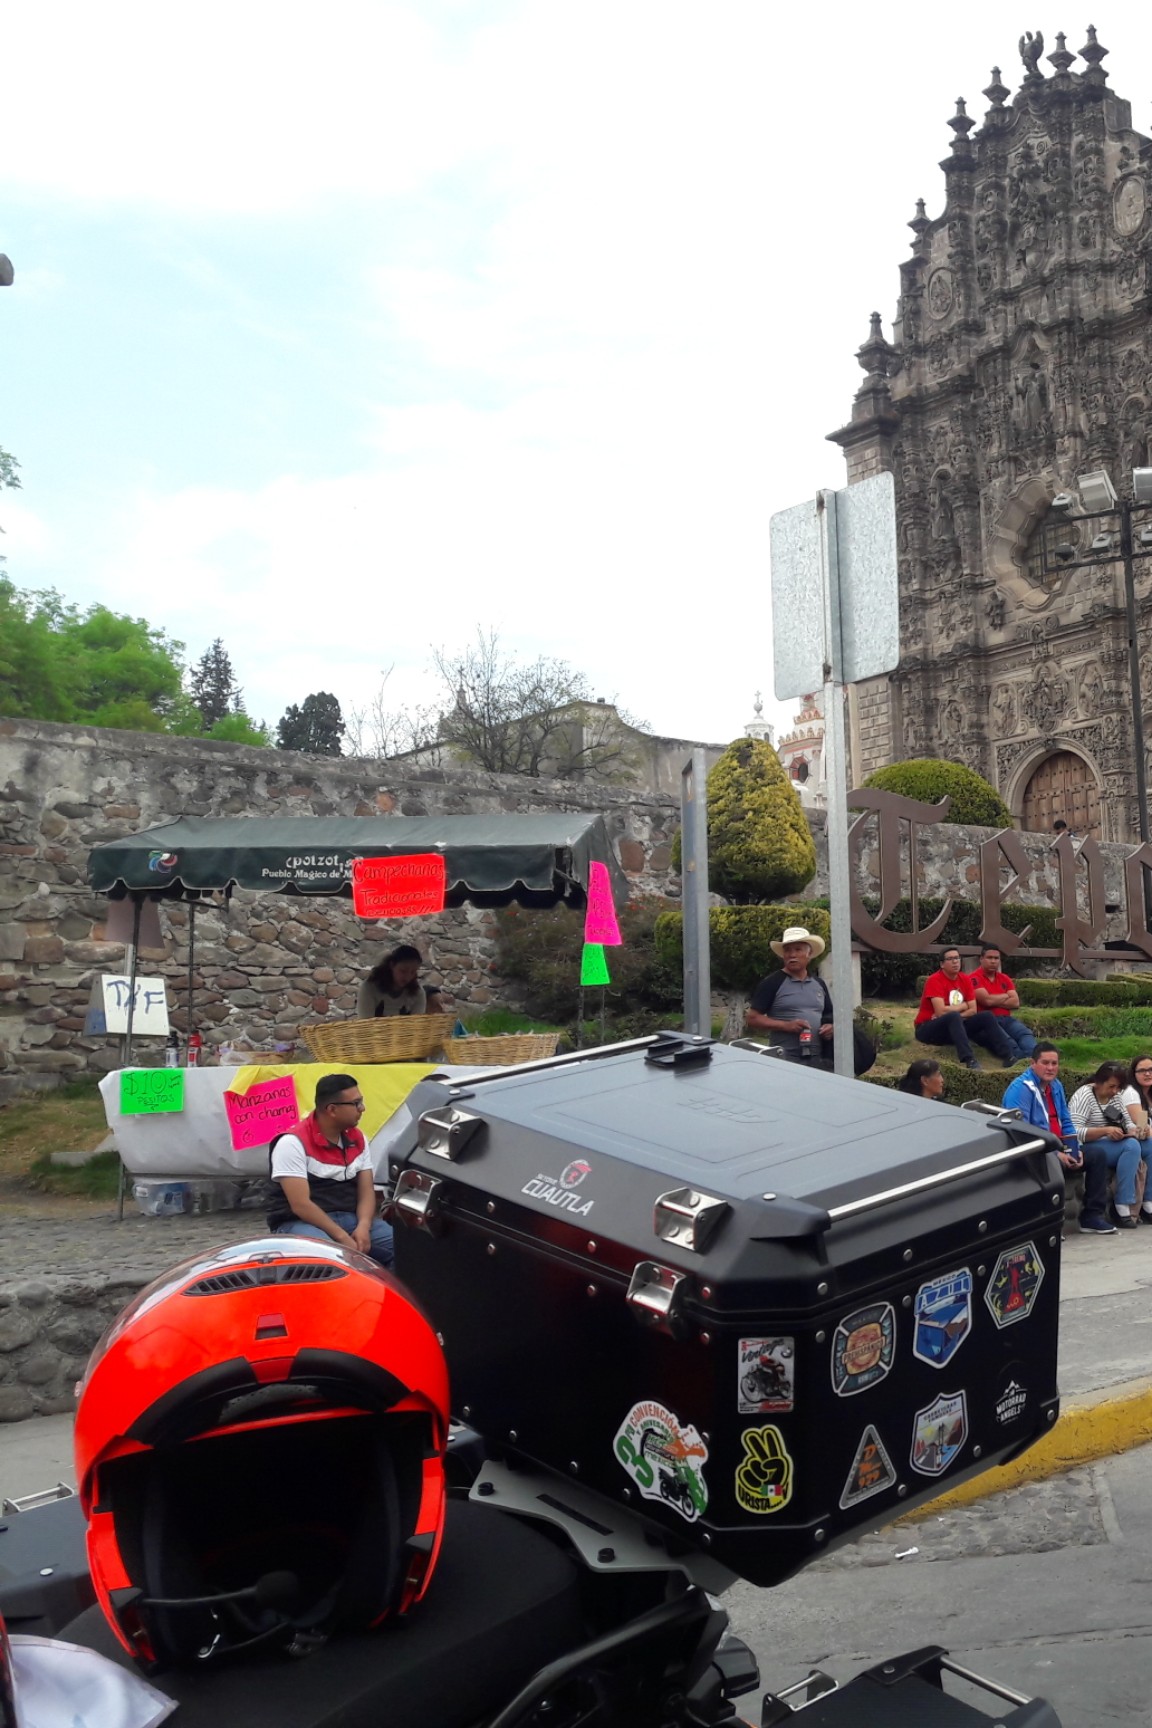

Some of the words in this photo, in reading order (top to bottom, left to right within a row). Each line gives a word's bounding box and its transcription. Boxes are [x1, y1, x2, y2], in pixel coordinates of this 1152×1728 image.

[262, 868, 292, 877] Pueblo
[329, 870, 341, 878] de
[521, 1179, 595, 1216] CUAUTLA
